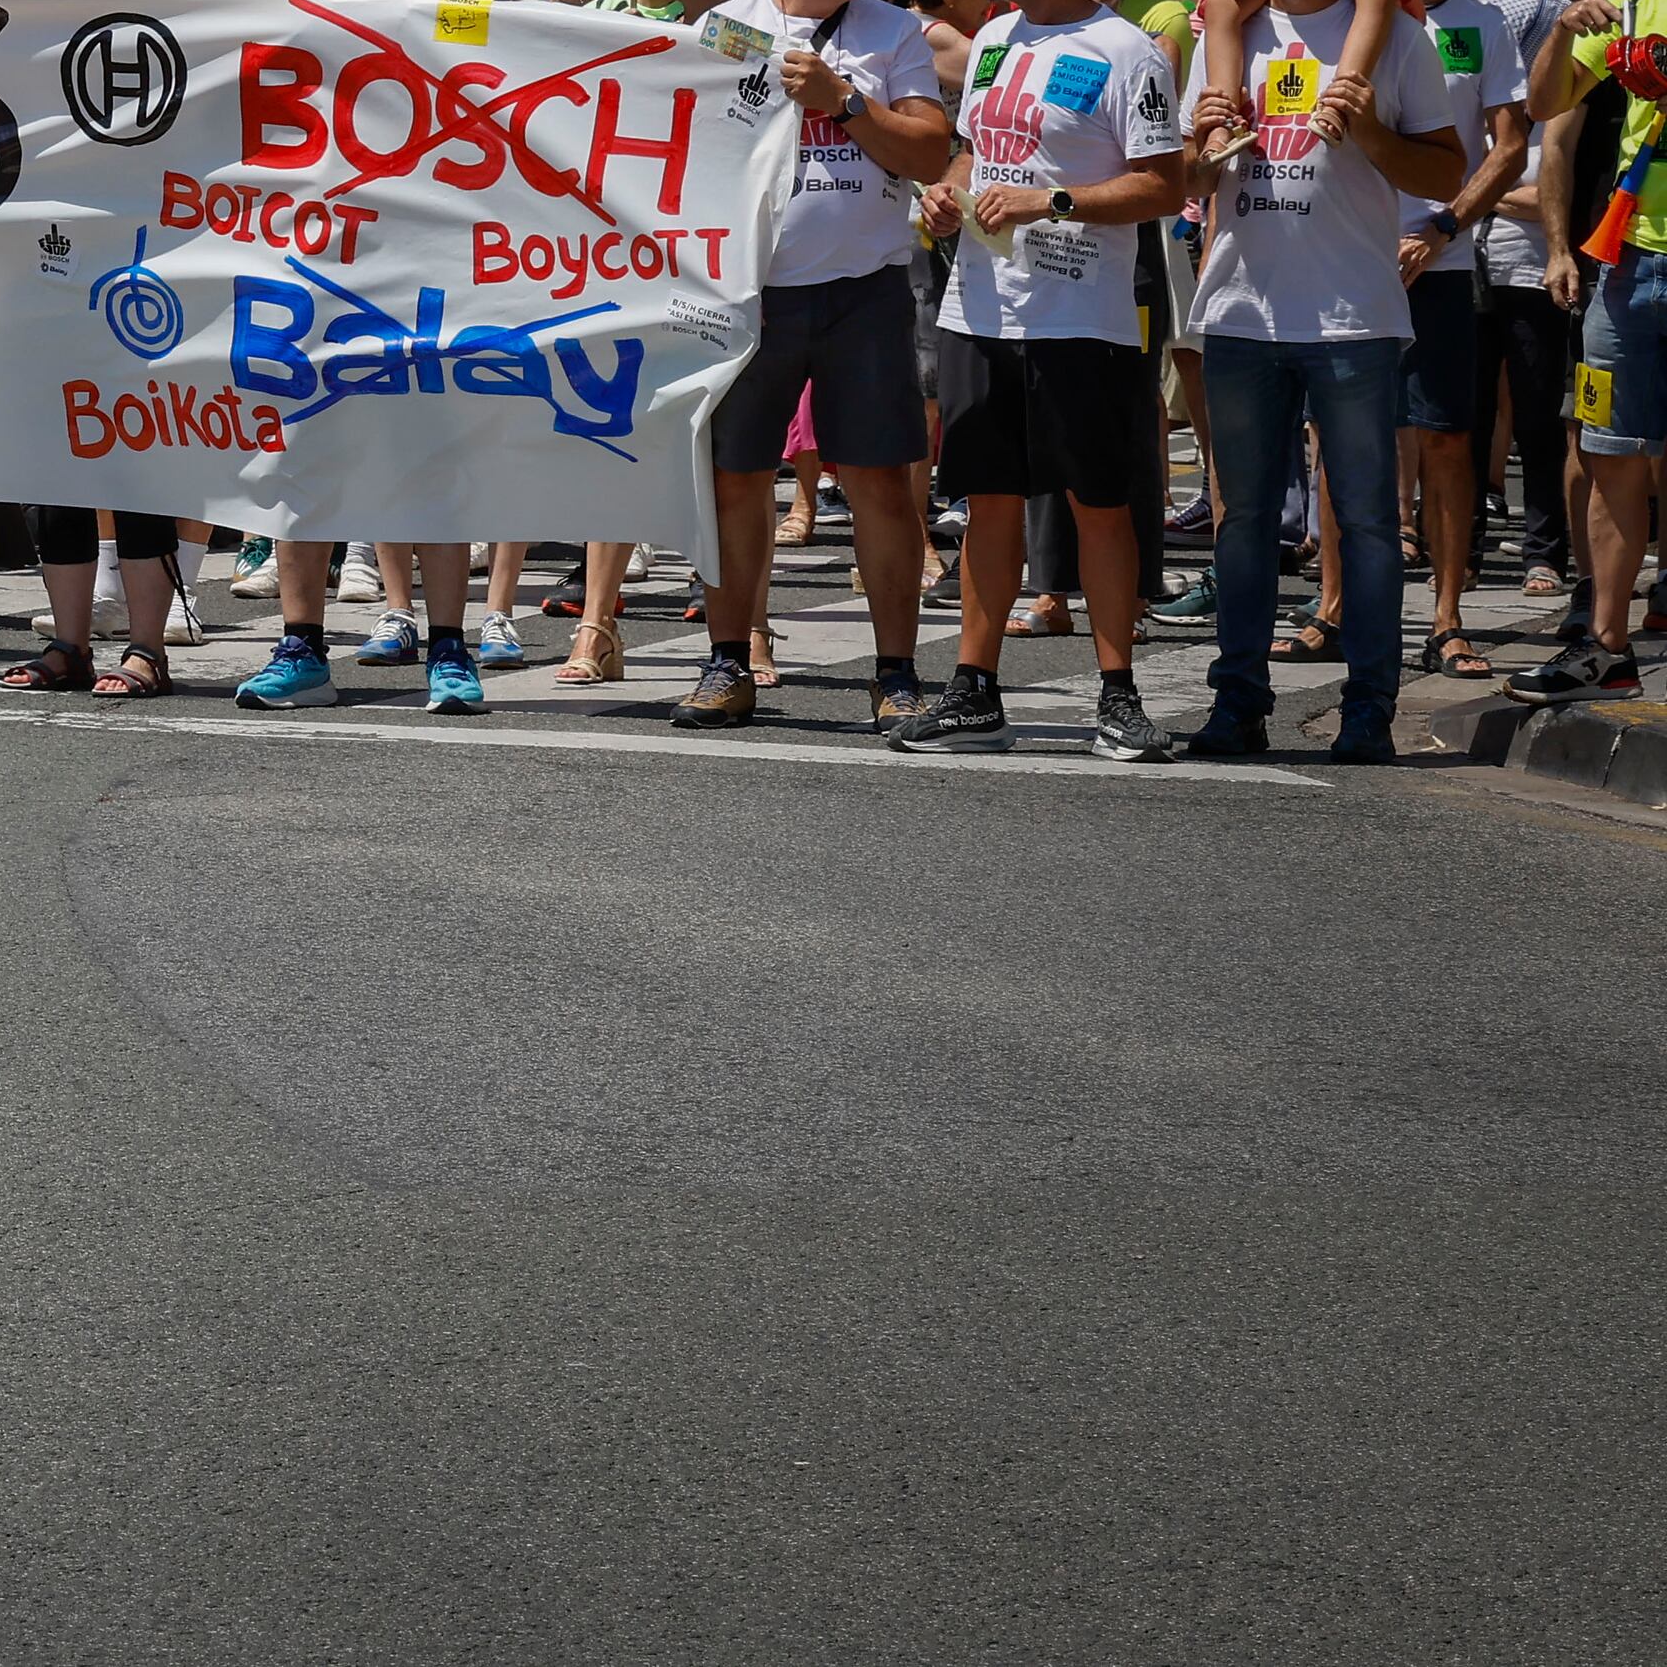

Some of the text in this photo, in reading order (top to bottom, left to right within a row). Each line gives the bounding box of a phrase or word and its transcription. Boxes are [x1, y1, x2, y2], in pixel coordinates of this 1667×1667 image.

[723, 18, 752, 37] 1000
[1051, 70, 1089, 85] AMIGOS
[1071, 64, 1107, 78] NO HAY
[968, 52, 1045, 141] FUCK
[1062, 87, 1095, 103] Balay
[240, 41, 697, 216] BOSCH
[799, 148, 862, 163] BOSCH
[975, 130, 1041, 165] YOU
[981, 166, 1035, 185] BOSCH
[1252, 164, 1315, 181] BOSCH
[806, 178, 863, 193] Balay
[1253, 197, 1311, 216] Balay
[1030, 230, 1062, 242] MARTES
[1024, 238, 1099, 258] DESPUES DEL LUNES
[1034, 260, 1068, 275] Balay
[1070, 257, 1086, 266] QUE
[672, 298, 730, 324] B/S/H CIERRA
[684, 314, 705, 326] ES LA
[673, 326, 697, 334] BOSCH
[232, 274, 646, 438] Balay
[939, 711, 999, 728] new balance
